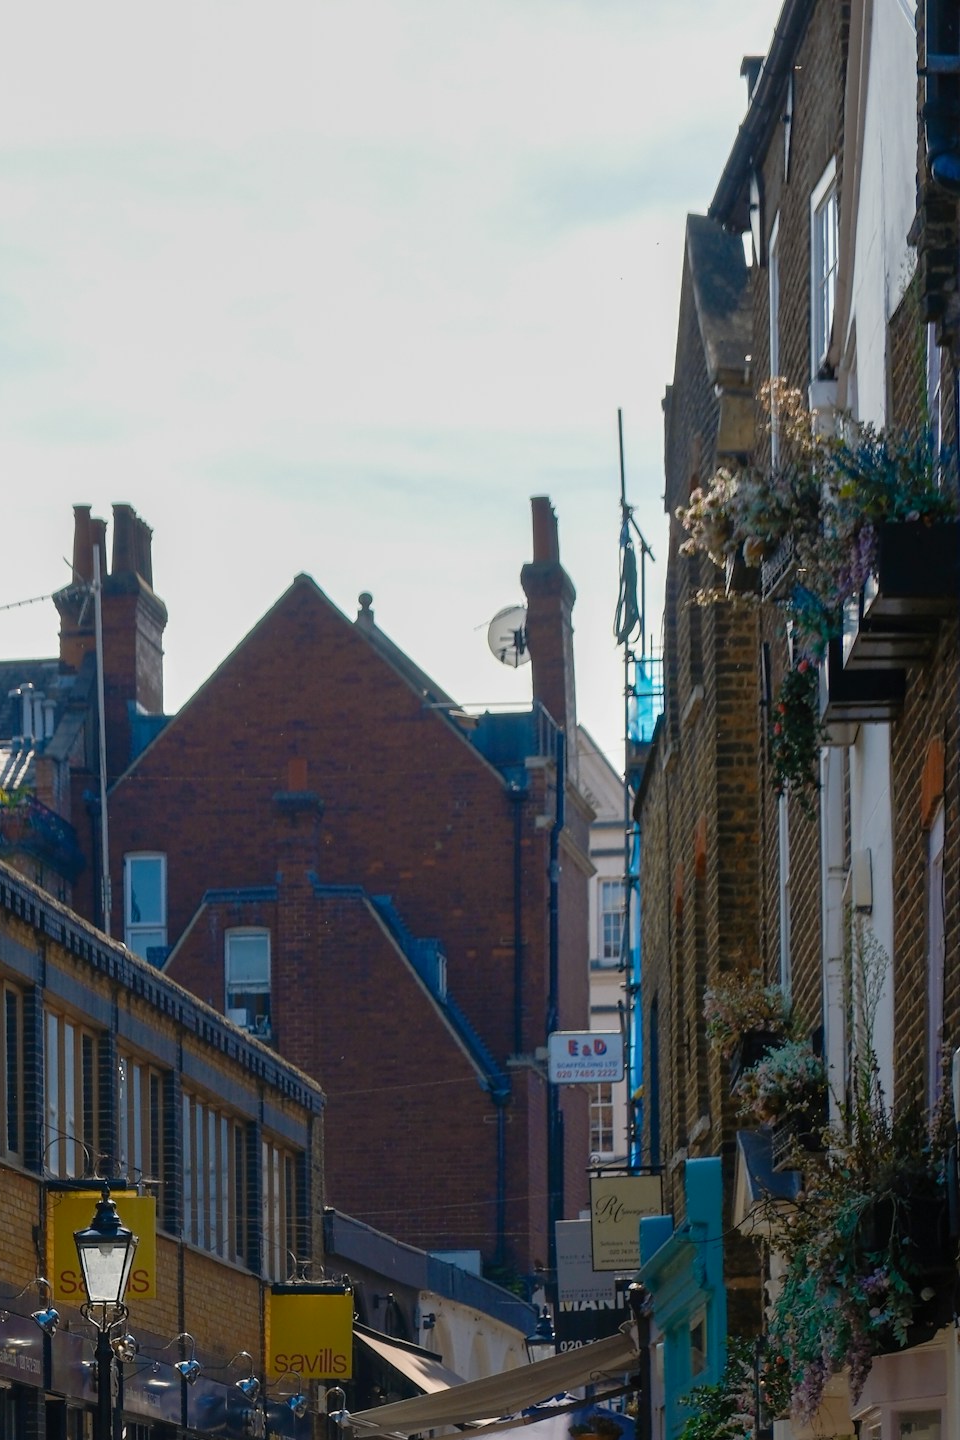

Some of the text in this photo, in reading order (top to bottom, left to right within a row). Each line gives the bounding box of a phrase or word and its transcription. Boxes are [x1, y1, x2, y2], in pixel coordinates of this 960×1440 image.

[568, 1039, 607, 1056] E & D
[556, 1070, 572, 1079] 020
[597, 1068, 618, 1077] 2222
[274, 1348, 347, 1374] savills
